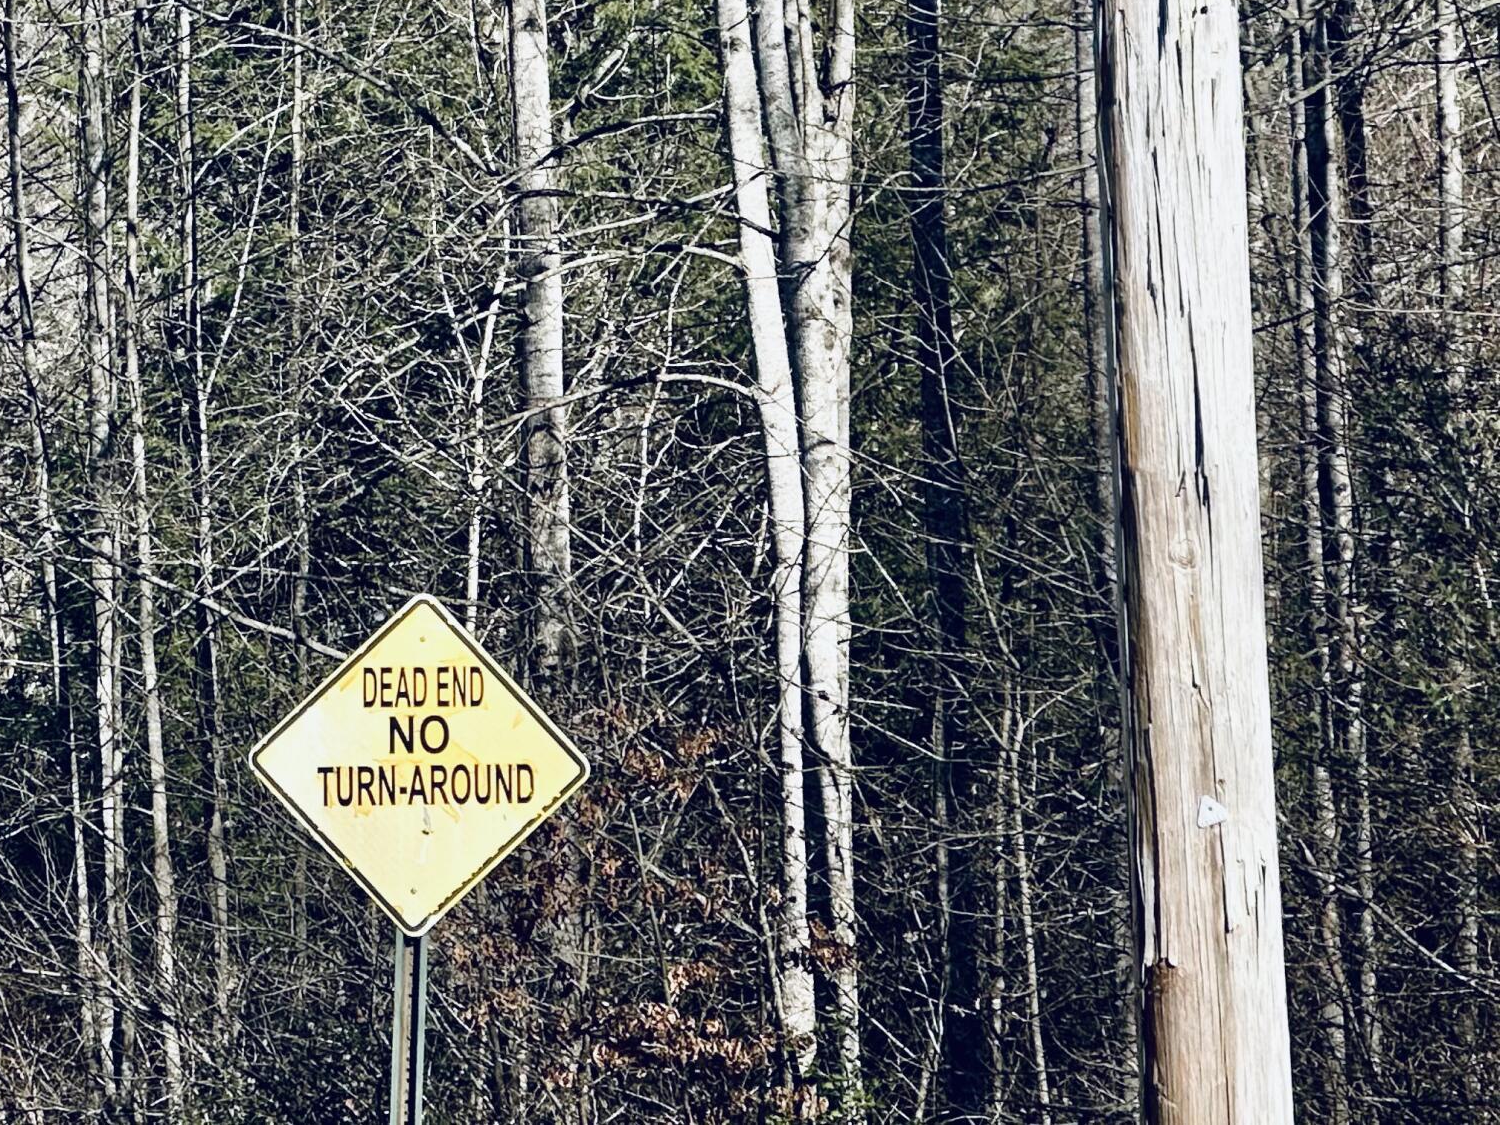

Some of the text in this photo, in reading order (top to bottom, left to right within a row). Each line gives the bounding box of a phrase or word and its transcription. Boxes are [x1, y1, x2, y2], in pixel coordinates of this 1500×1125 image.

[363, 666, 485, 708] DEAD END
[389, 715, 450, 754] NO
[317, 763, 535, 807] TURN-AROUND
